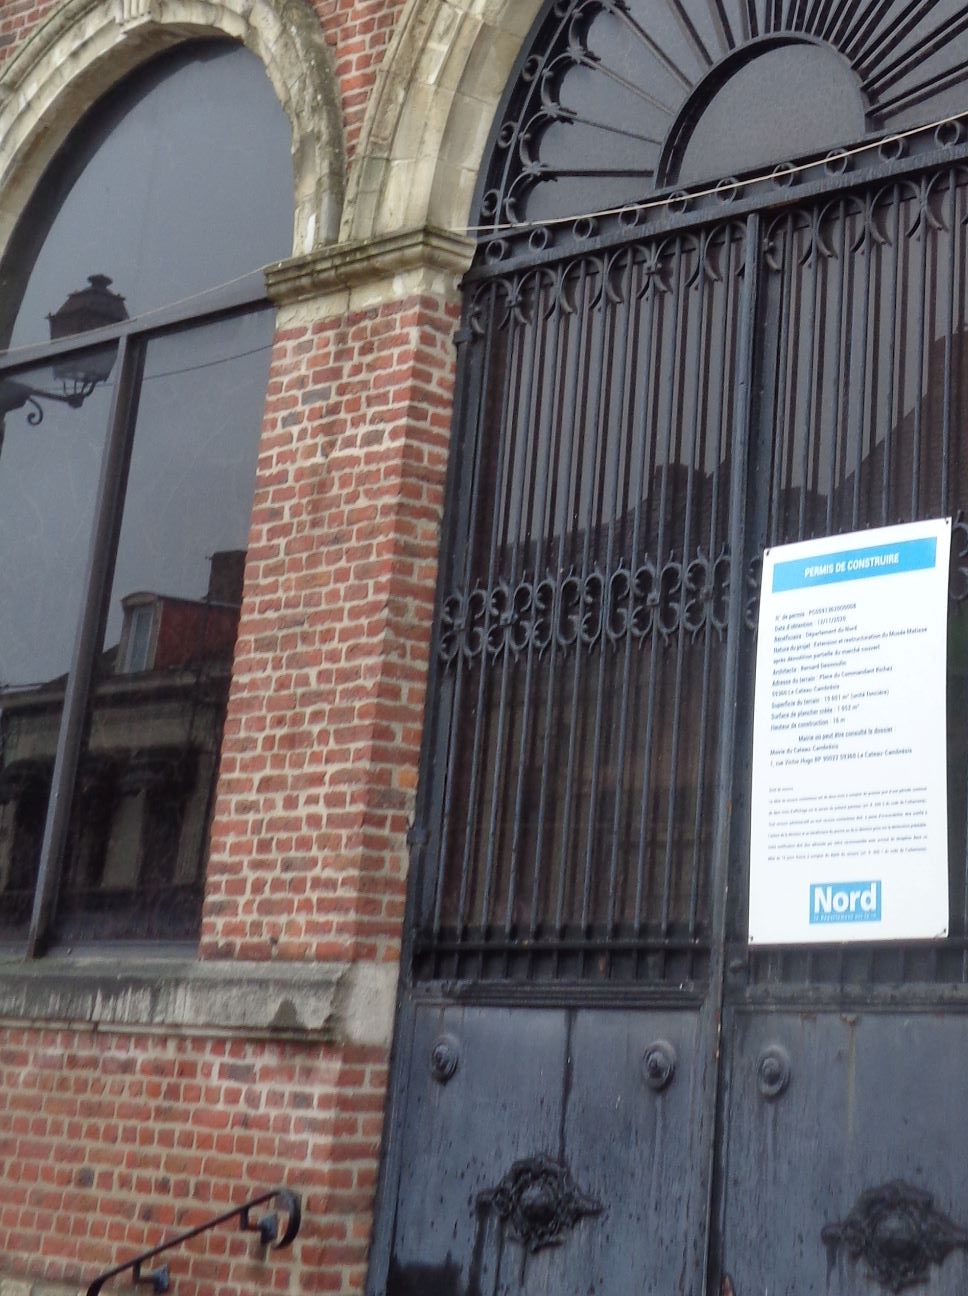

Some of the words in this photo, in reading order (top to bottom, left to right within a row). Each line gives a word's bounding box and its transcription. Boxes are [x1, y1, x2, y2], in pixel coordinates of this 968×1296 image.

[804, 563, 834, 578] PERMIS
[836, 563, 846, 573] DE
[848, 552, 899, 572] CONSTRUIRE
[814, 882, 877, 913] Nord
